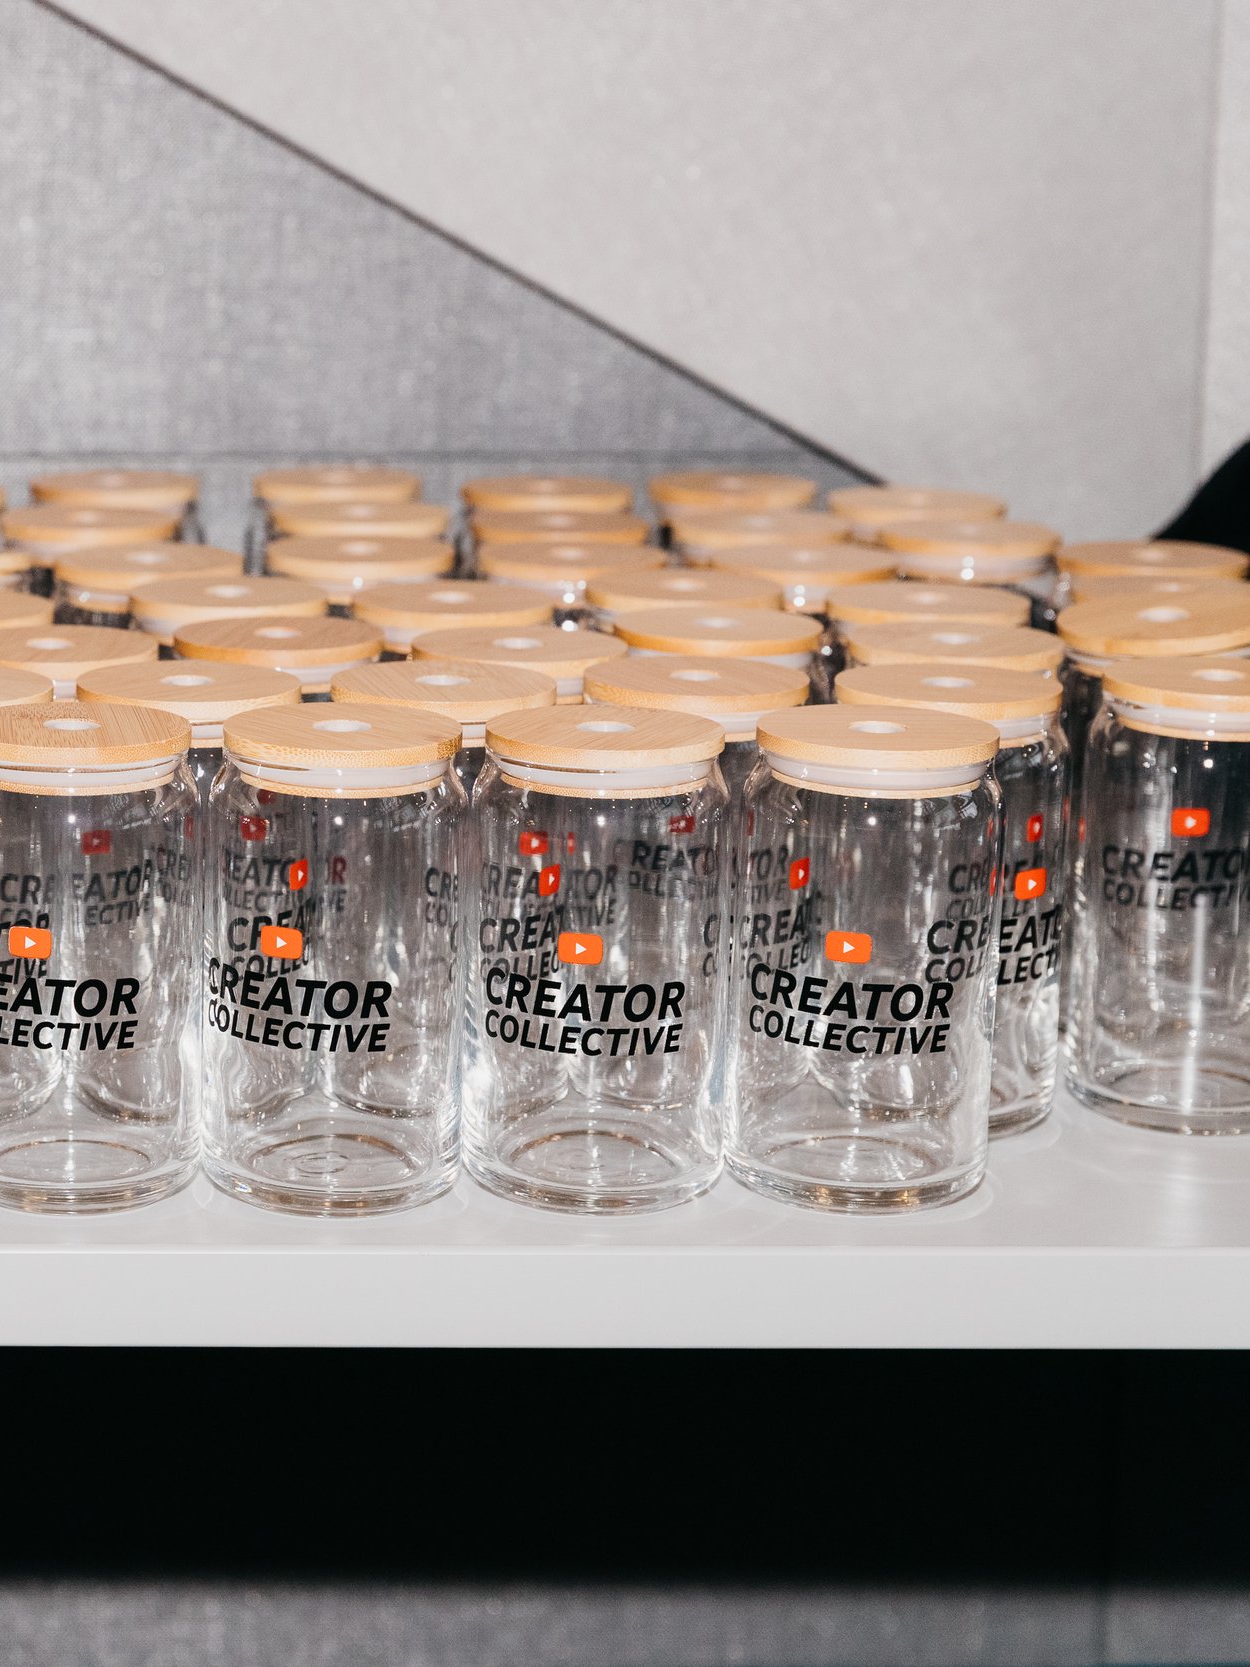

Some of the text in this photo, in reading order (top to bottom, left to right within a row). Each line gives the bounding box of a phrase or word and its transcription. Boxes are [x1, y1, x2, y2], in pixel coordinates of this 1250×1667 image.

[208, 957, 392, 1019] CREATOR
[486, 967, 686, 1023] CREATOR
[751, 963, 954, 1021] CREATOR
[208, 999, 391, 1053] COLLECTIVE
[485, 1010, 684, 1056] COLLECTIVE
[749, 1005, 951, 1055] COLLECTIVE
